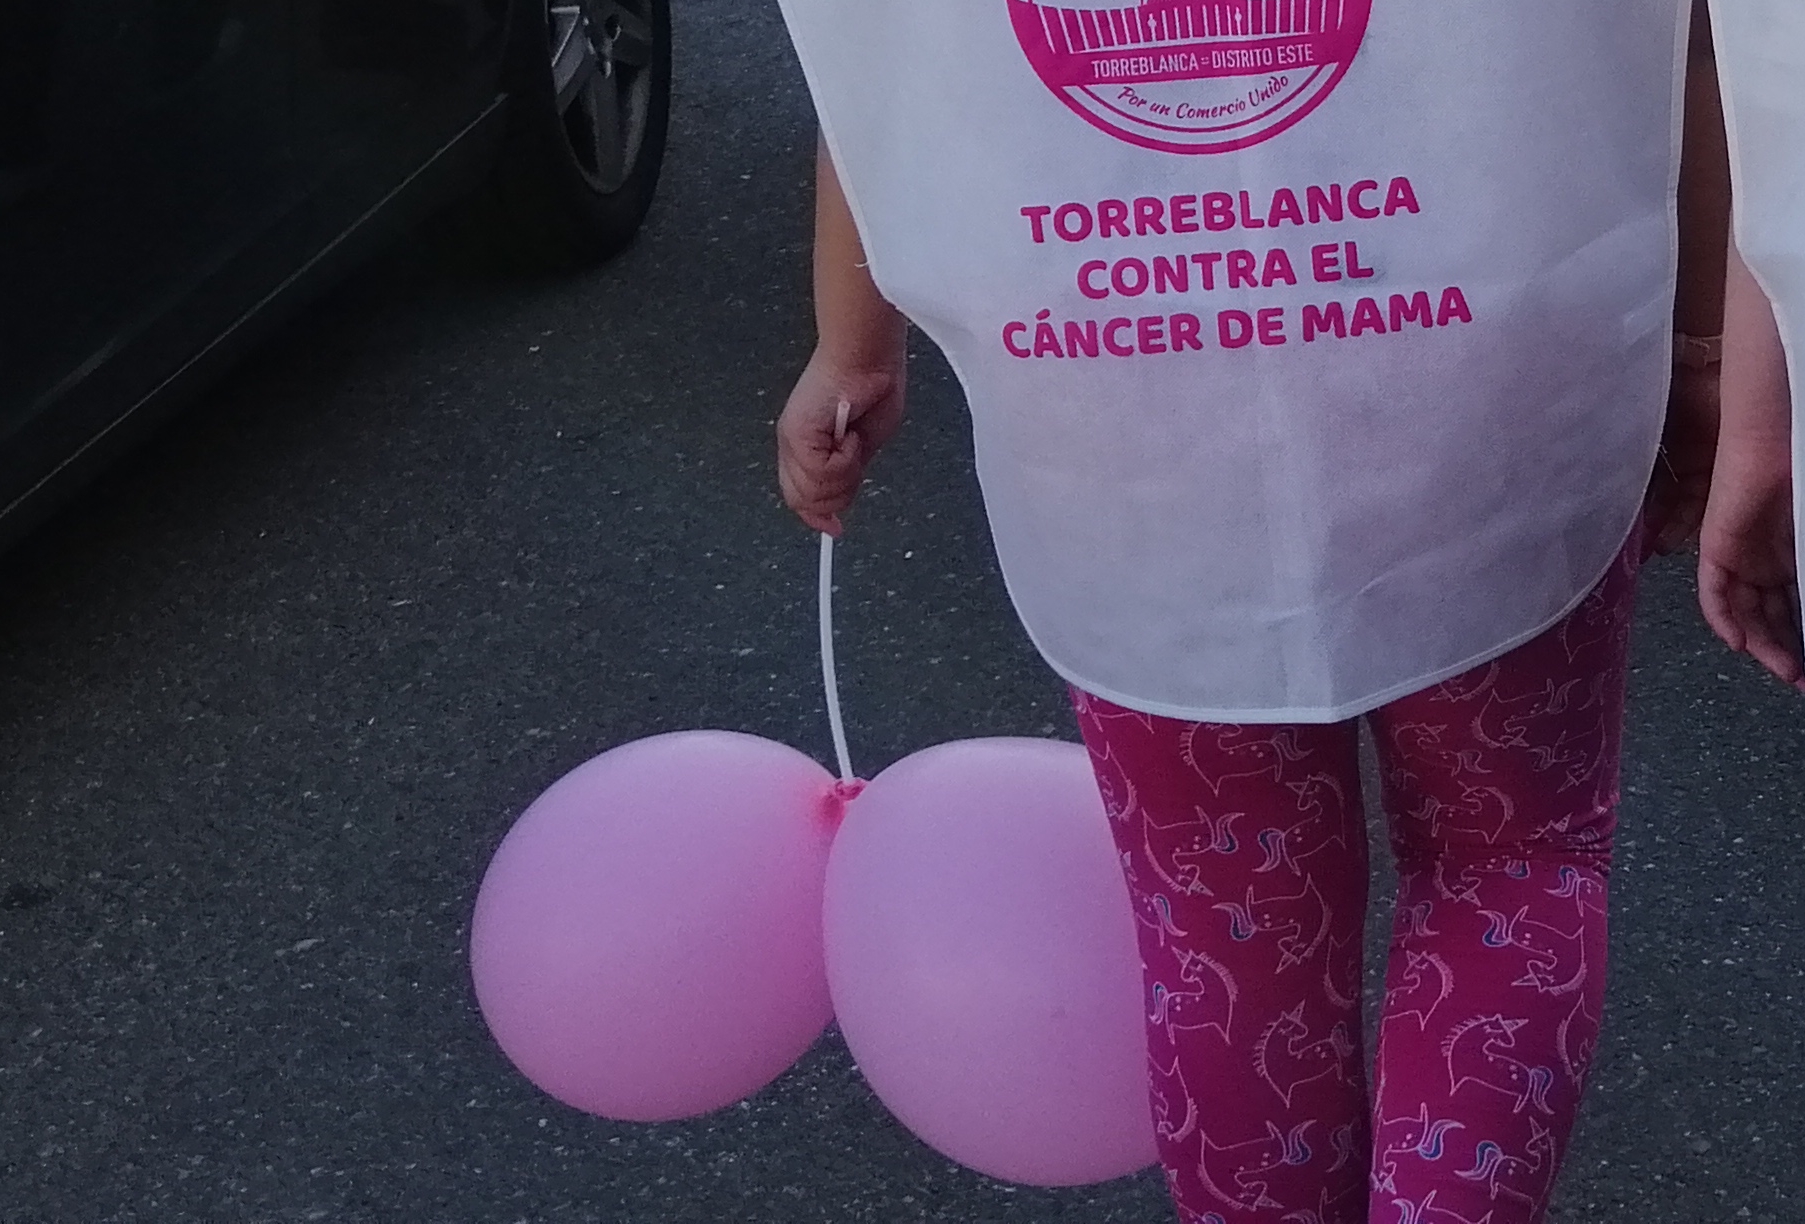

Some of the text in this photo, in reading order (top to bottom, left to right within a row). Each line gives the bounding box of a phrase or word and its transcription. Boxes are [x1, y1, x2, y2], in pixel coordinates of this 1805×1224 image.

[1091, 52, 1200, 79] TORREBLANCA
[1211, 47, 1273, 69] DISTRITO
[1277, 43, 1314, 64] ESTE
[1117, 75, 1290, 119] Por un Comercio Unido
[1020, 176, 1421, 243] TORREBLANCA
[1076, 241, 1374, 300] CONTRA EL
[1001, 286, 1473, 359] CÁNCER DE MAMA
